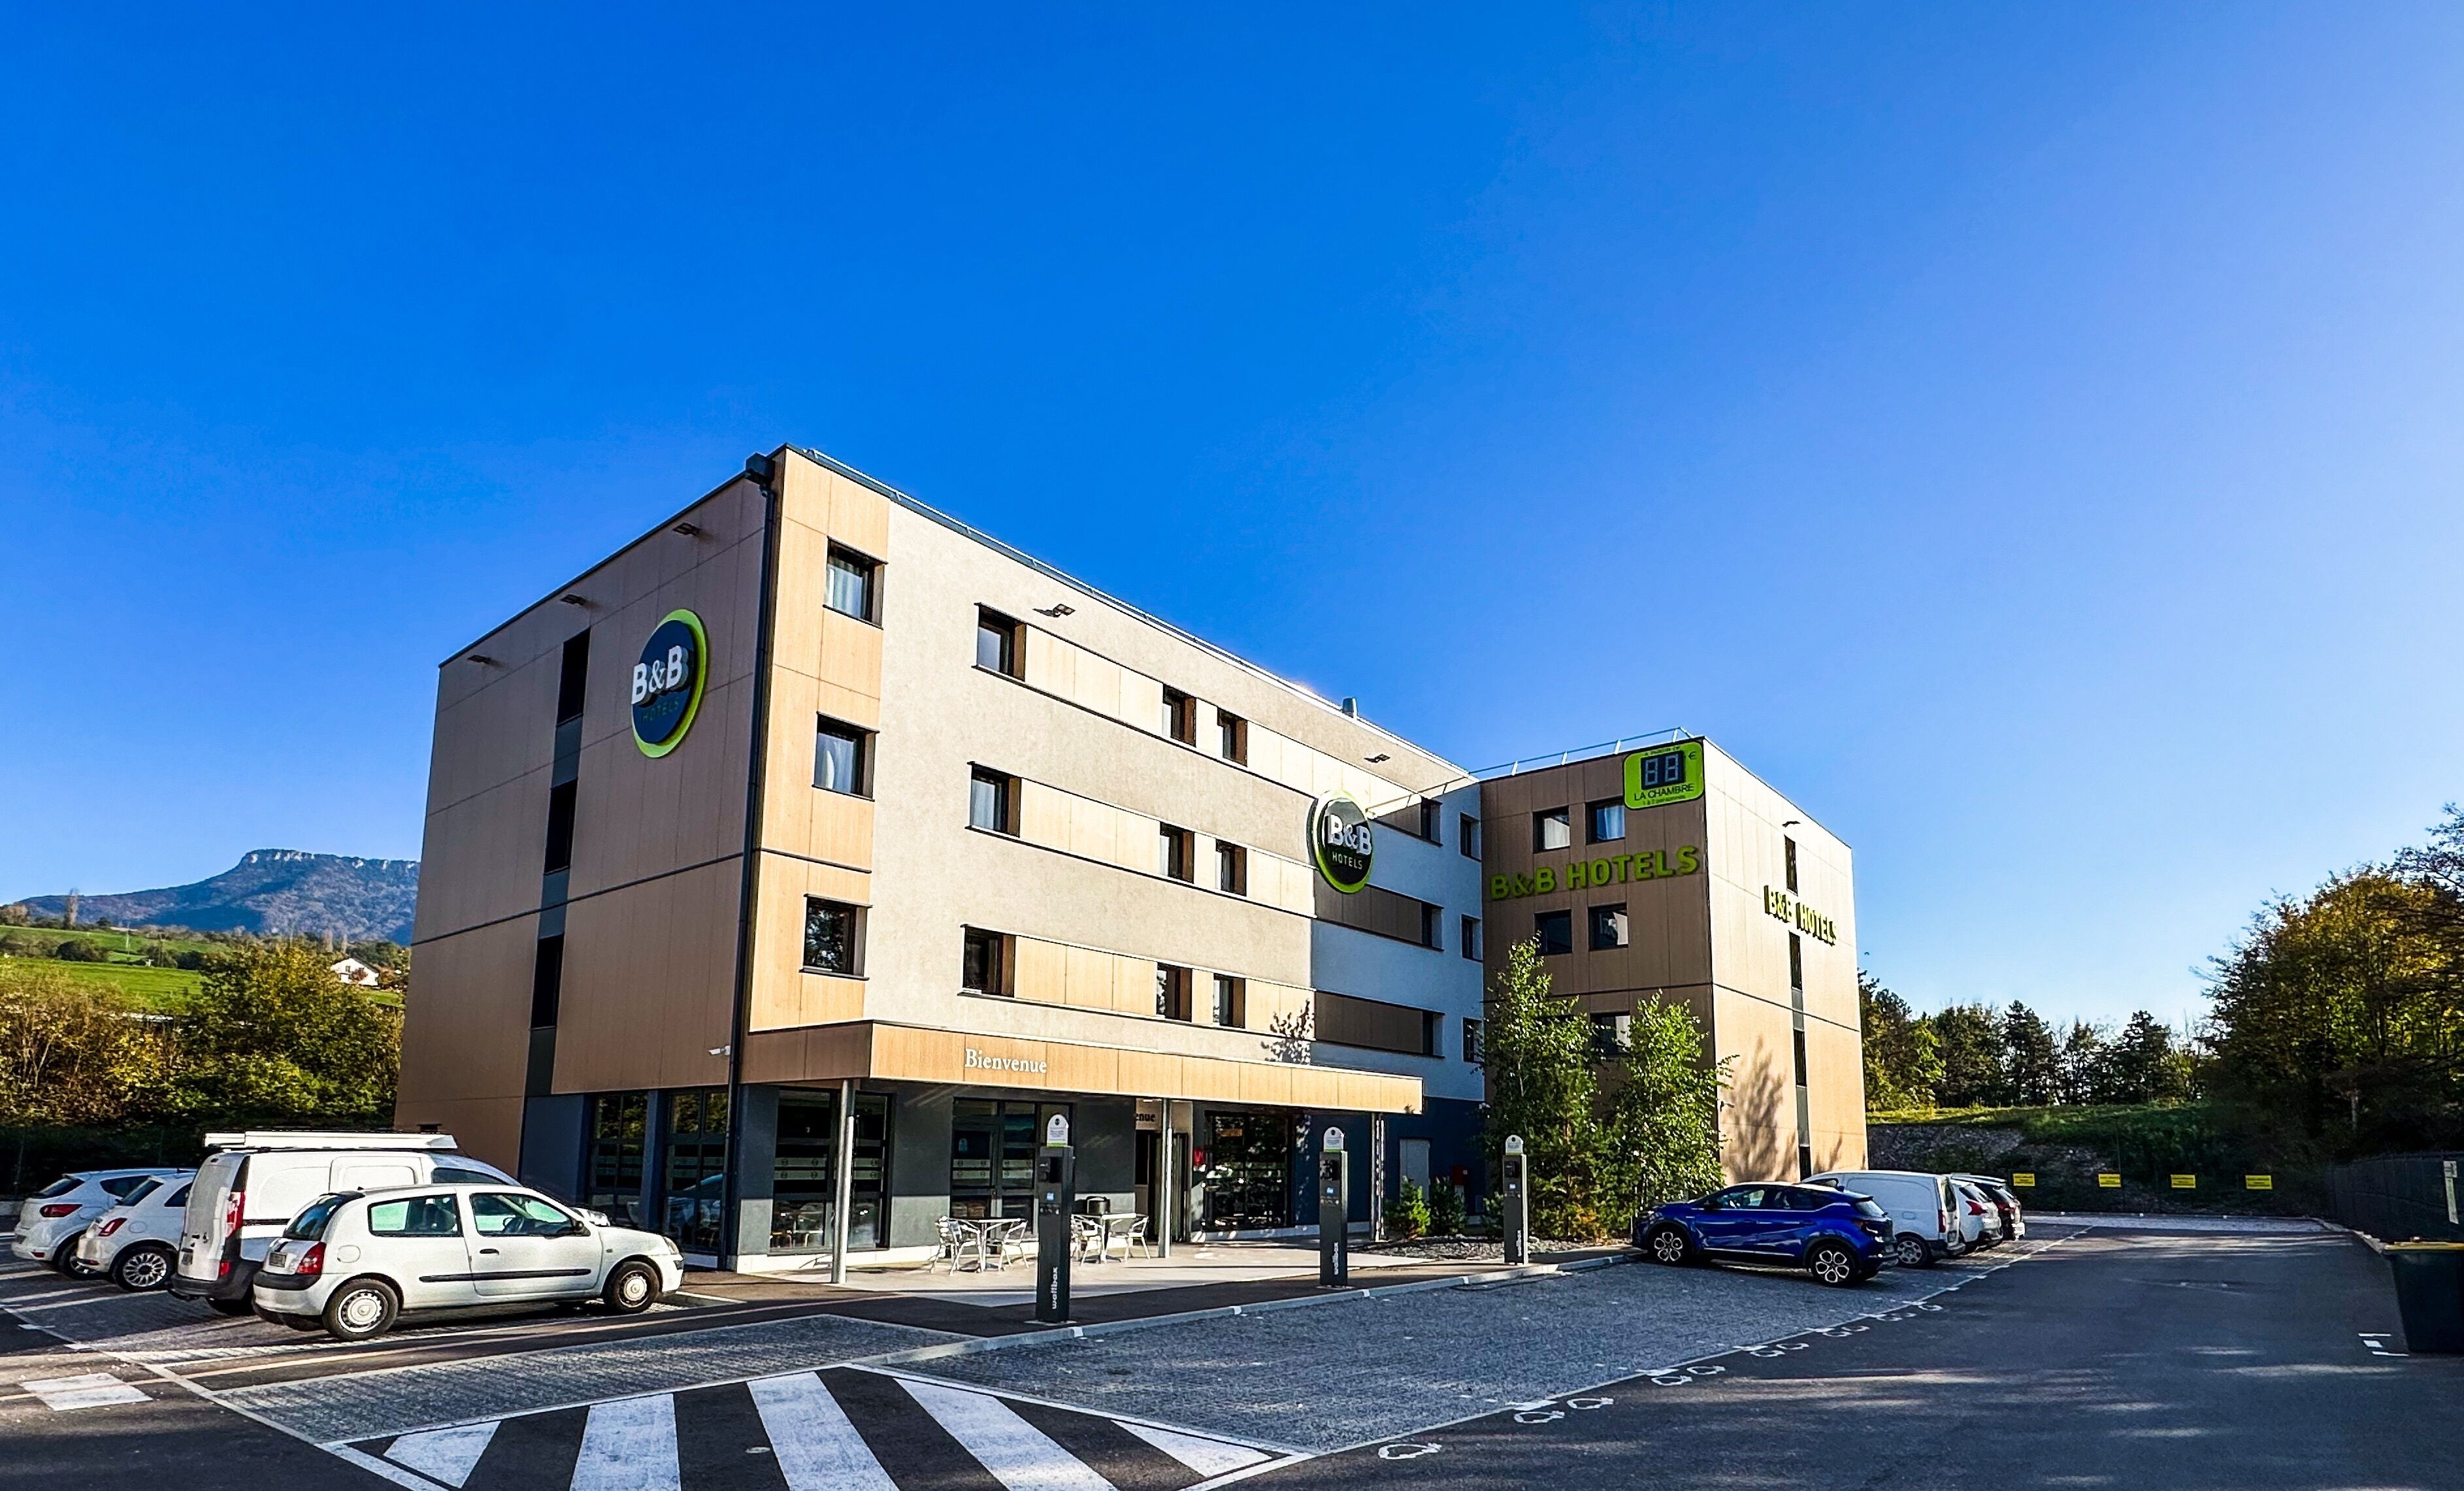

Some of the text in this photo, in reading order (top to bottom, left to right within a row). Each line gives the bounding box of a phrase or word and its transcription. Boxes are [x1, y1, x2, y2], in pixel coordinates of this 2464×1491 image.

[631, 645, 686, 705] B&B
[1634, 792, 1646, 801] LA
[1647, 783, 1694, 799] CHAMBRE
[1327, 813, 1372, 855] B&B
[1332, 851, 1363, 870] HOTELS
[1489, 845, 1700, 900] B&B HOTELS
[1764, 885, 1794, 923] B&B
[964, 1047, 1047, 1073] Bienvenue
[1050, 1266, 1059, 1309] wallbox
